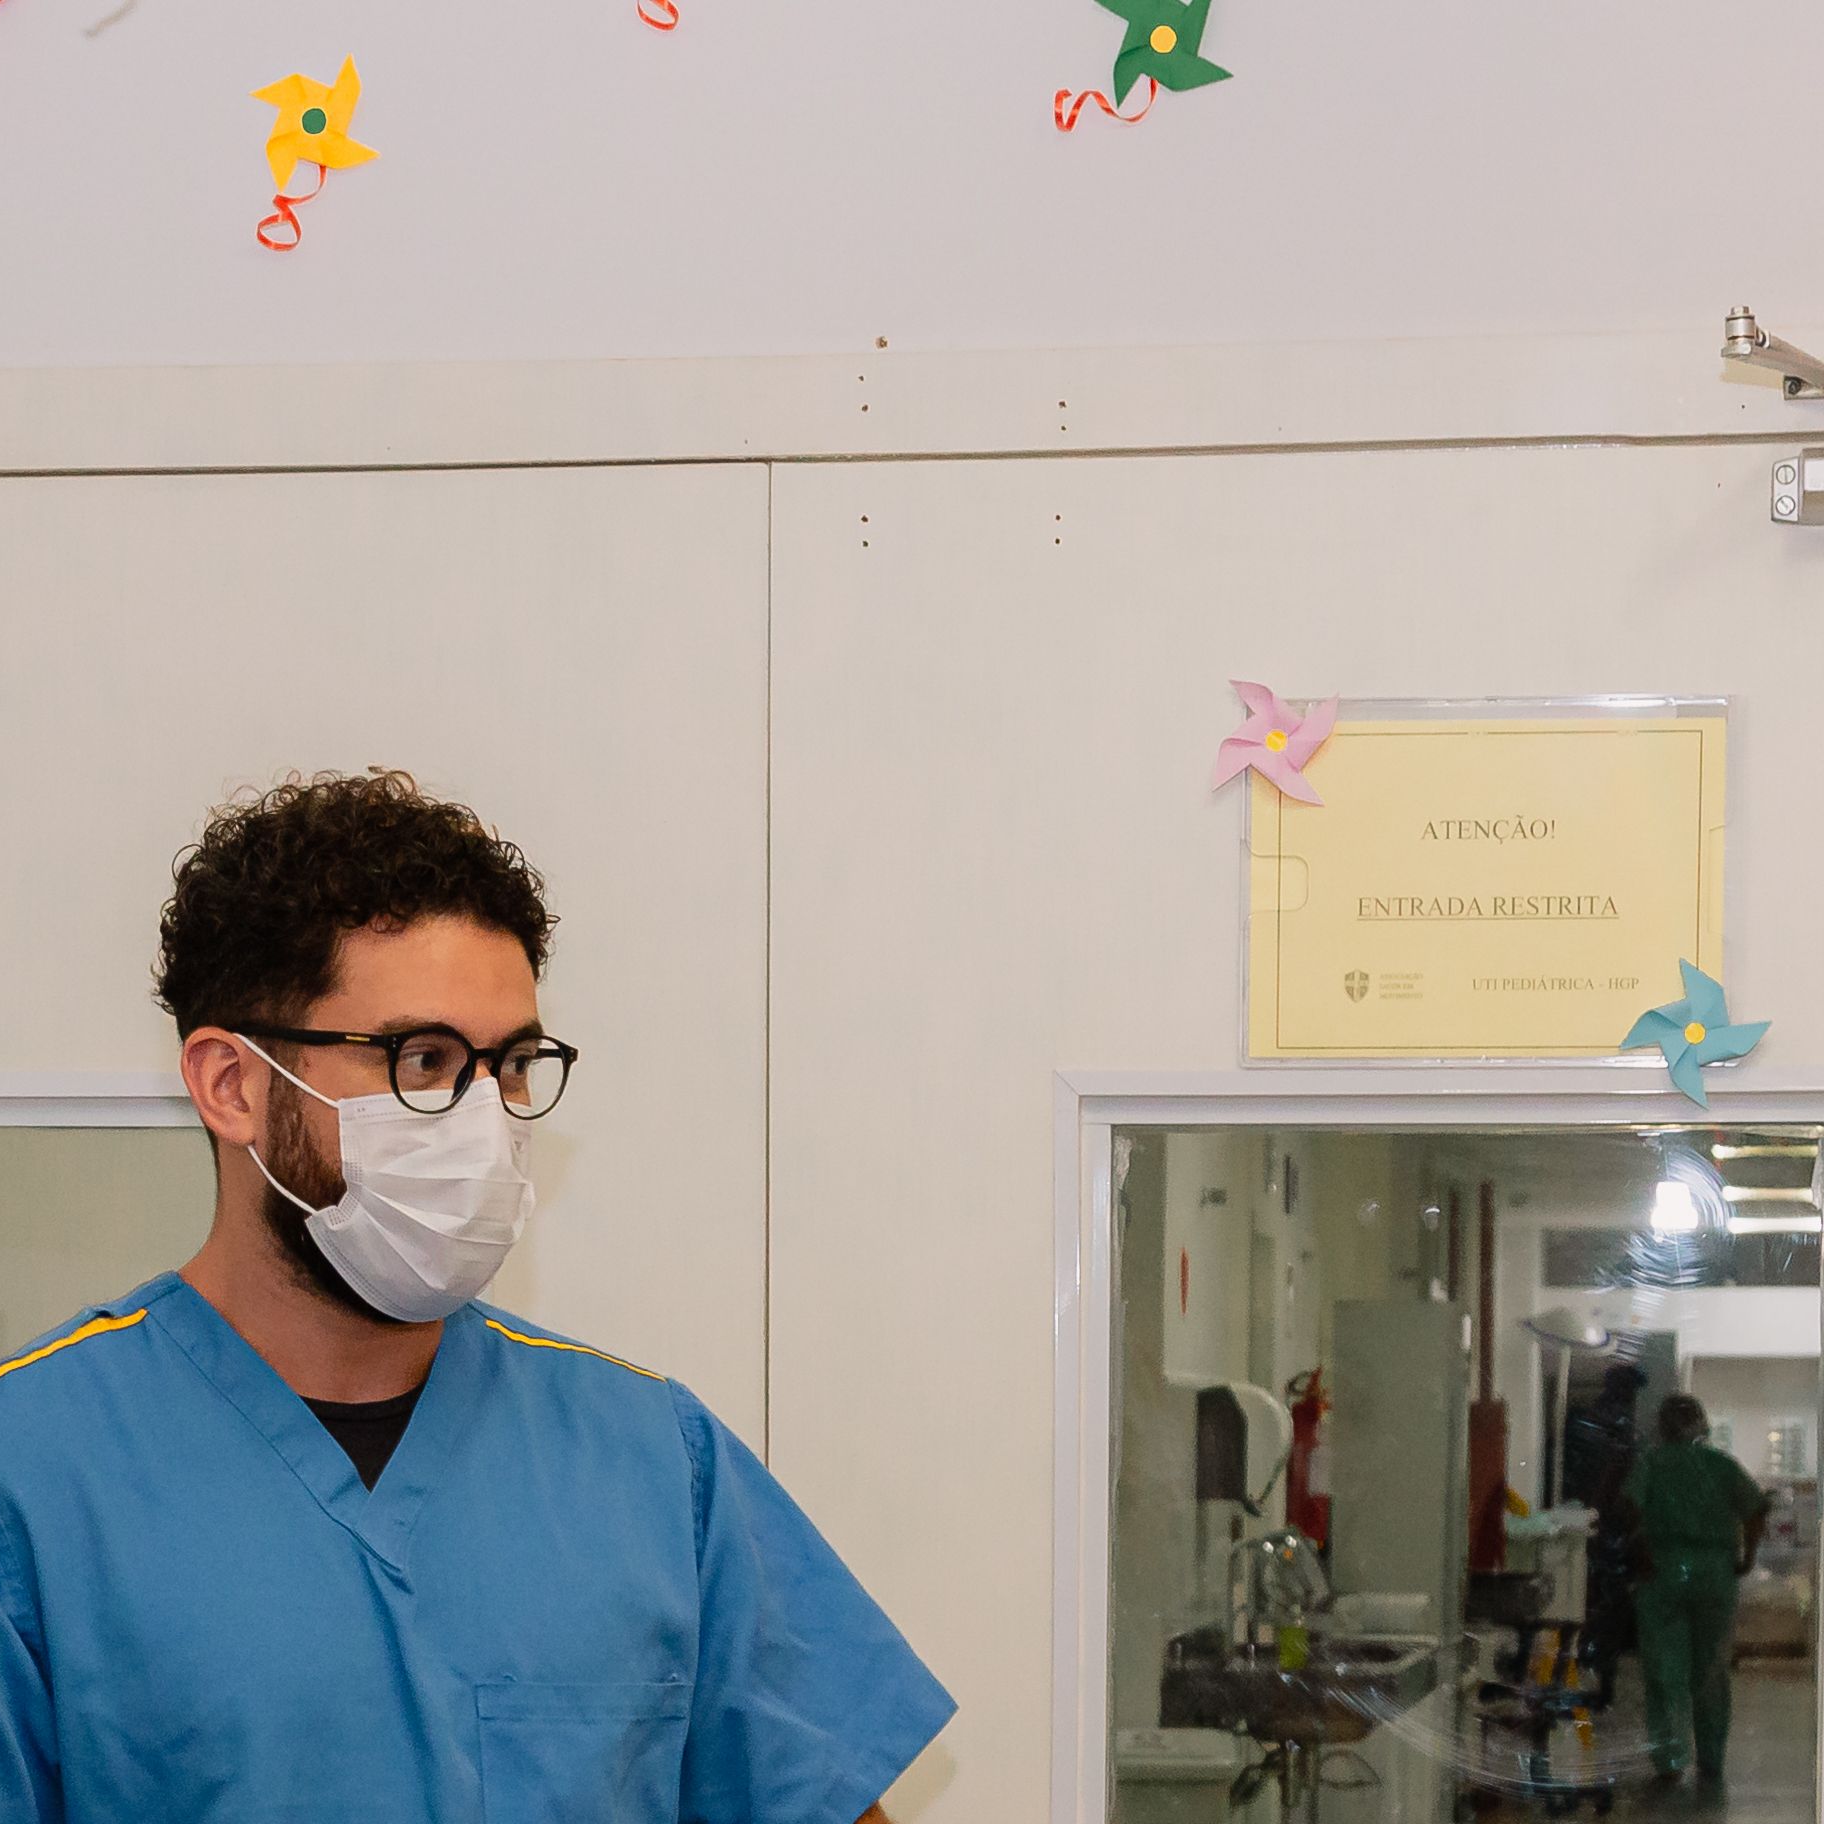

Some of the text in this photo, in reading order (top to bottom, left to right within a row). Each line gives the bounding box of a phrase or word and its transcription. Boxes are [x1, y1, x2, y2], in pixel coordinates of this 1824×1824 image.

[1420, 814, 1556, 845] ATENÇÃO!
[1357, 895, 1619, 917] ENTRADA RESTRITA
[1472, 978, 1498, 991] UTI
[1502, 975, 1595, 991] PEDIÁTRICA
[1608, 977, 1640, 990] HGP
